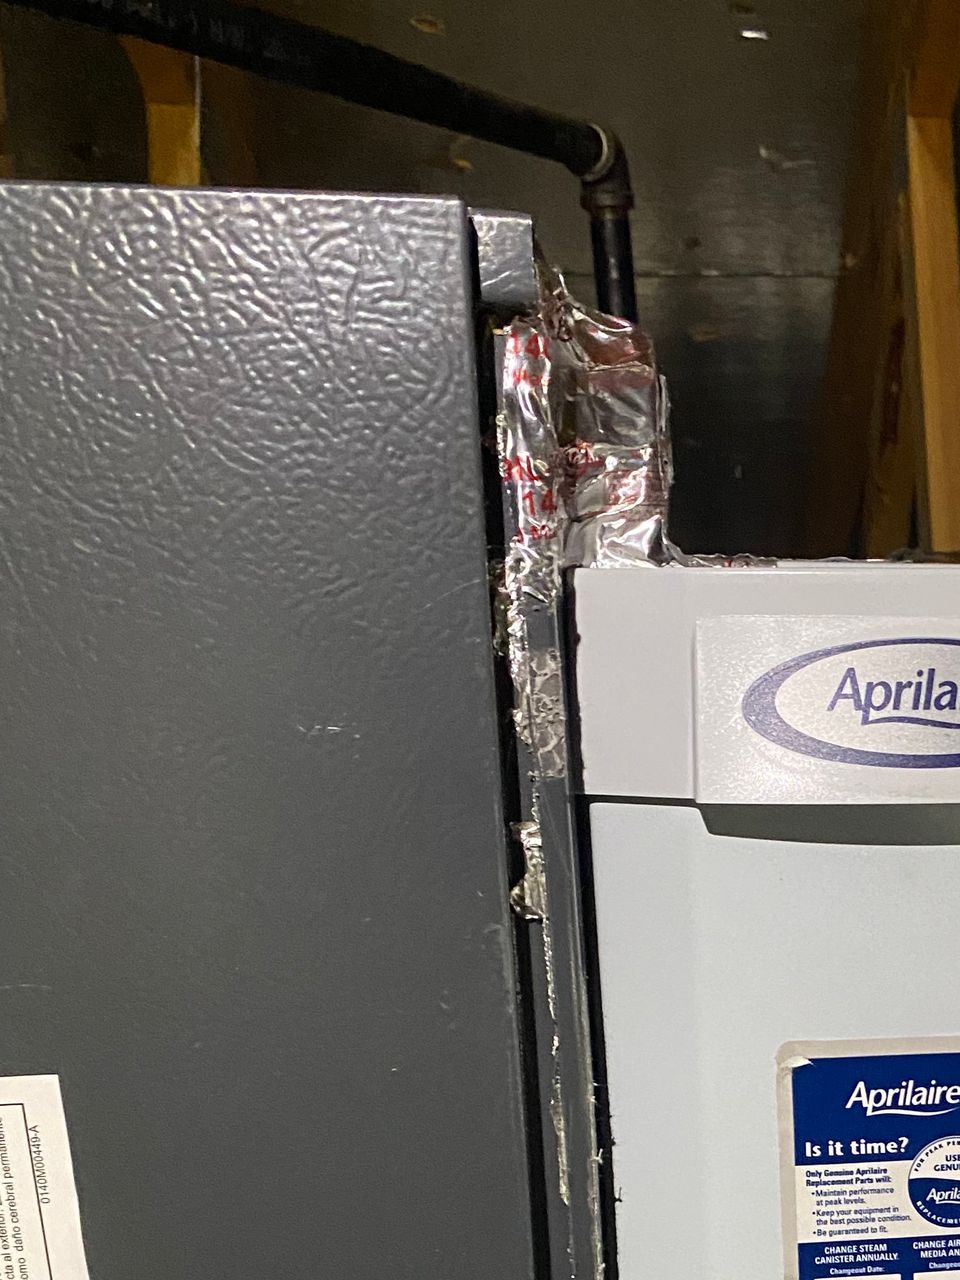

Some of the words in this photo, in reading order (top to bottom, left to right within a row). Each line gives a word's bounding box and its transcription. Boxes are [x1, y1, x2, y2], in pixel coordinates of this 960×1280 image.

[805, 1142, 821, 1157] Is
[828, 1140, 843, 1156] it
[850, 1137, 909, 1155] time?
[915, 1159, 924, 1172] FOR
[926, 1144, 943, 1157] PEAK
[29, 1124, 50, 1204] 0140M00449-A
[806, 1170, 822, 1178] Only
[856, 1167, 887, 1176] Aprilaire
[806, 1179, 853, 1187] Replacement
[849, 1187, 894, 1196] performance
[3, 1181, 19, 1224] cerebral
[825, 1198, 841, 1207] peak
[816, 1210, 834, 1219] Keep
[836, 1209, 852, 1217] your
[854, 1207, 891, 1216] equipment
[830, 1217, 845, 1225] best
[847, 1215, 876, 1225] possible
[829, 1227, 869, 1237] guaranteed
[11, 1225, 24, 1252] daño
[825, 1245, 858, 1255] CHANGE
[859, 1244, 887, 1252] STEAM
[913, 1239, 946, 1250] CHANGE
[948, 1239, 960, 1247] AIR
[815, 1254, 854, 1264] CANISTER
[920, 1249, 947, 1258] MEDIA
[830, 1267, 866, 1275] Changeout
